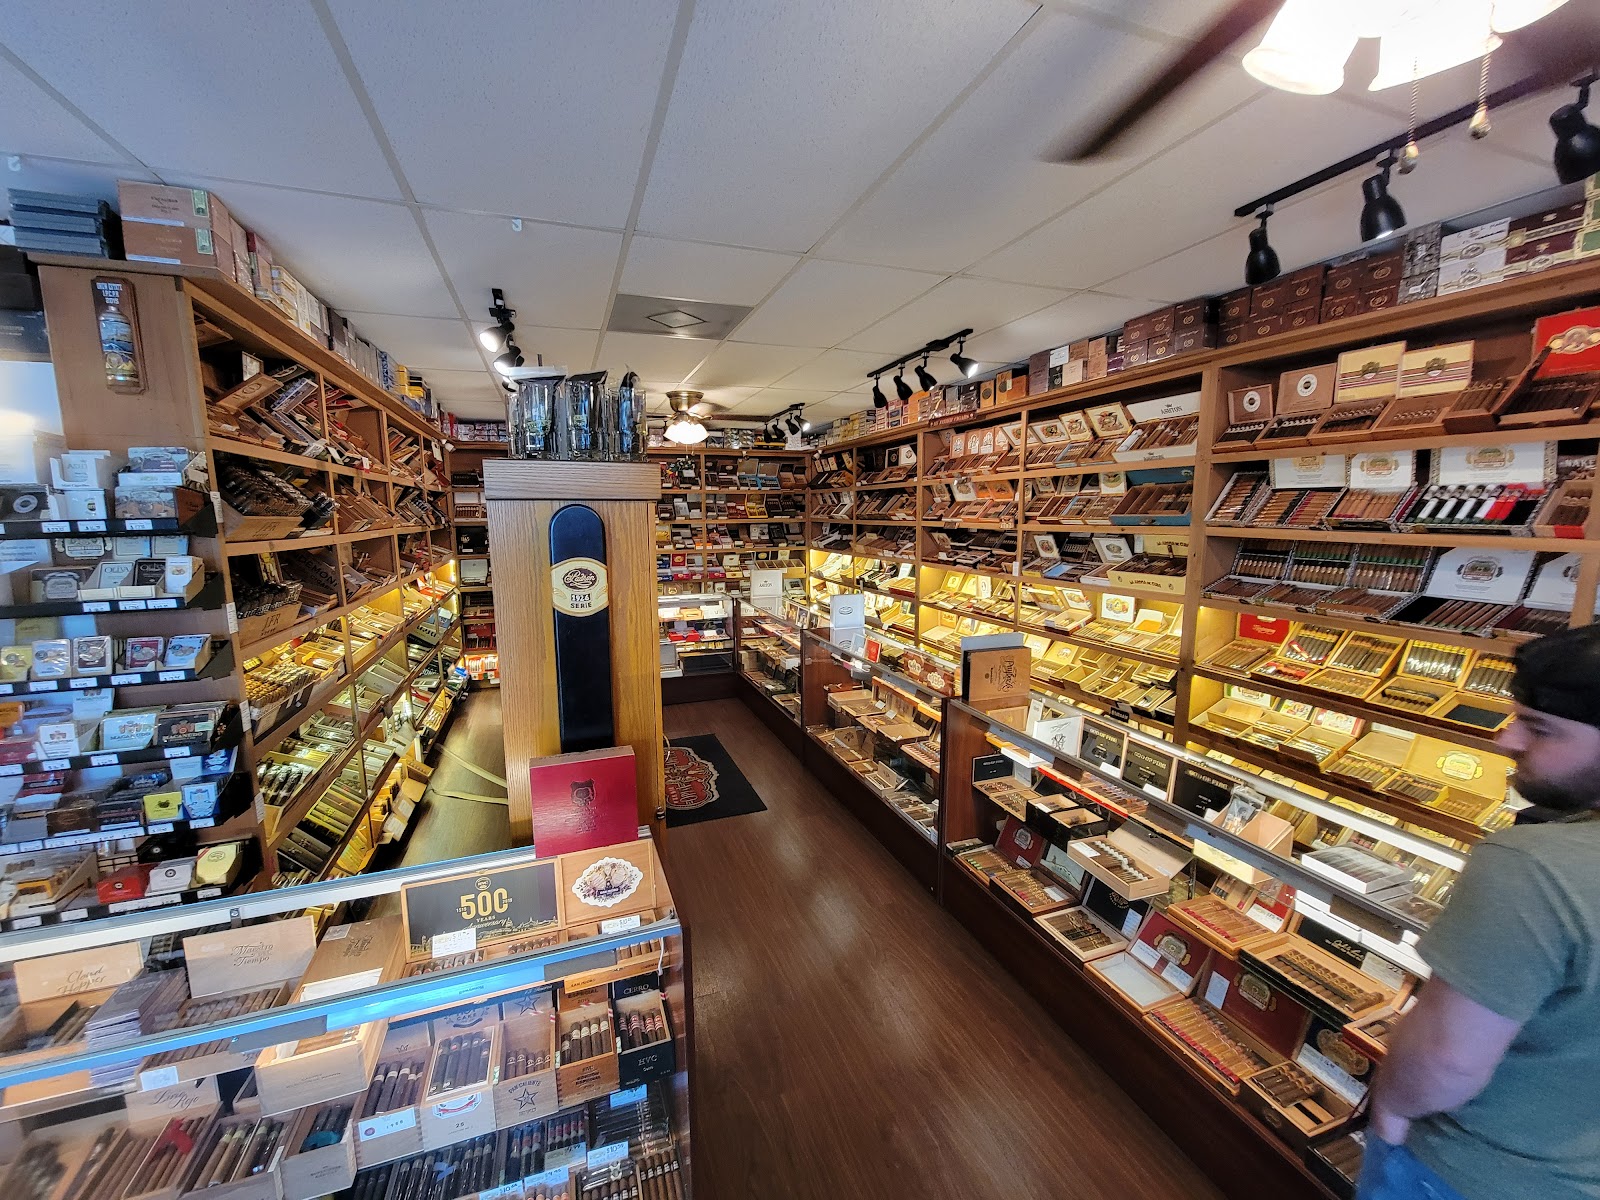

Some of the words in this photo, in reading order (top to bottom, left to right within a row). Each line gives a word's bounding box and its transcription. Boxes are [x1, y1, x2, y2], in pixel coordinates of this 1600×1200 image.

[1160, 405, 1184, 416] ASHTON
[104, 565, 130, 574] OLIVA
[570, 593, 591, 602] 1926
[570, 601, 593, 609] SERIE
[110, 731, 151, 741] MACANUDO
[161, 731, 204, 742] MACANUDO
[475, 914, 497, 923] YEARS
[233, 955, 271, 968] Tiempo
[67, 965, 105, 984] Cloud
[57, 974, 107, 994] Hopper
[623, 983, 650, 995] CERRO
[637, 1054, 658, 1067] HVC
[169, 1092, 200, 1109] Rojo
